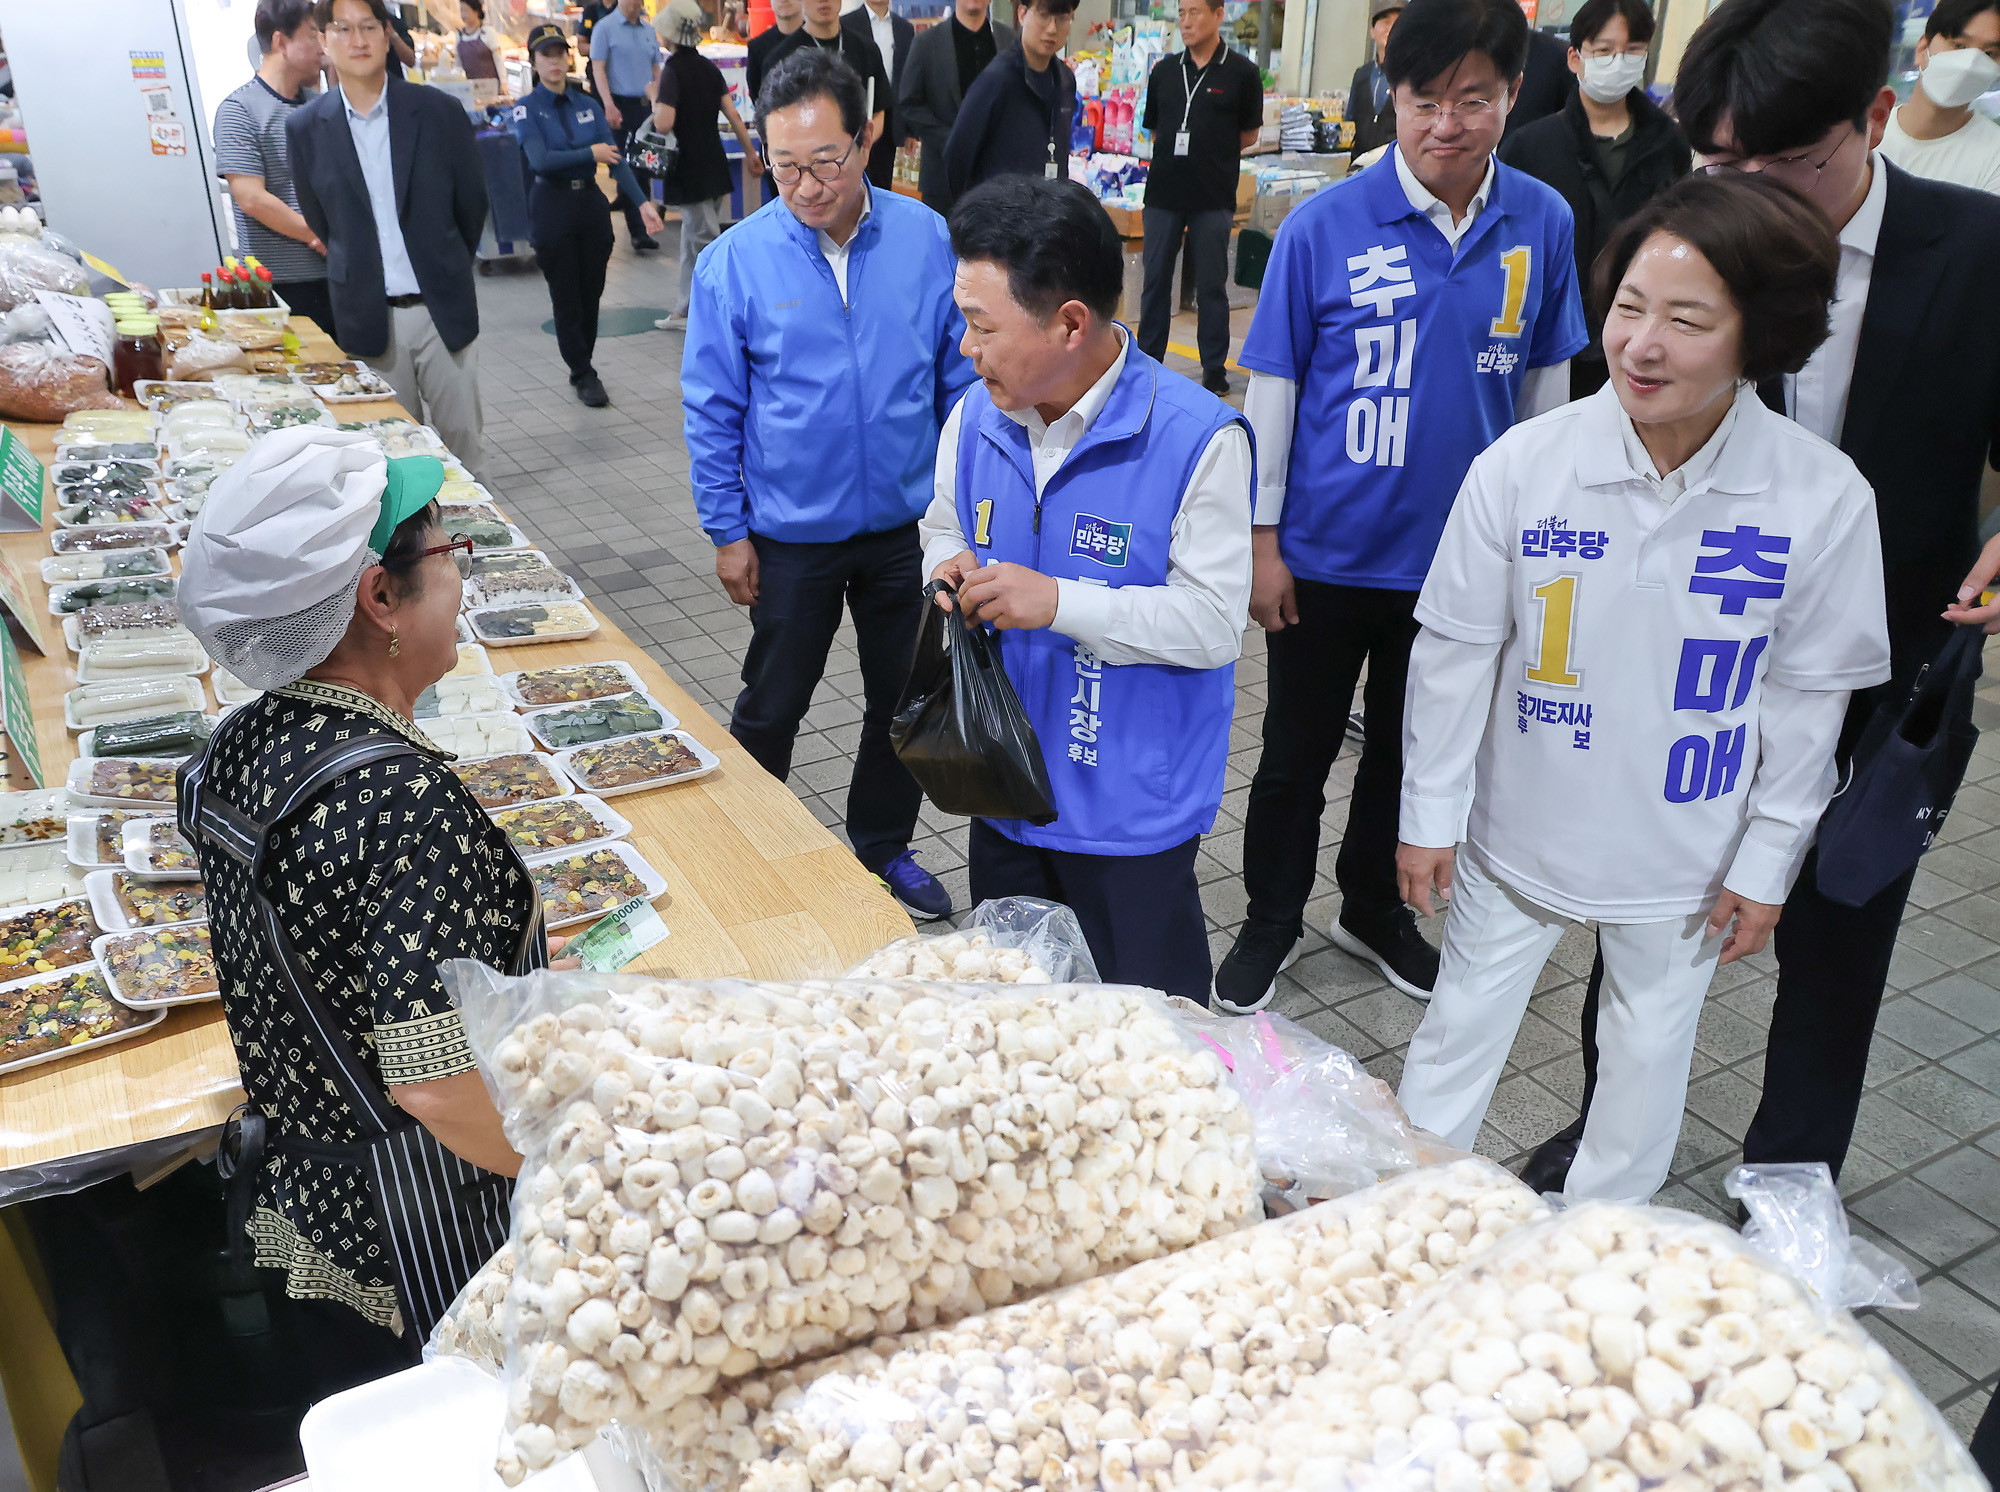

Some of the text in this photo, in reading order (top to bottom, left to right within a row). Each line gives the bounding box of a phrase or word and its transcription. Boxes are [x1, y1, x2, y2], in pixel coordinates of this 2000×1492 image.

[1488, 245, 1532, 338] 1
[1345, 244, 1417, 467] 추미애
[1476, 351, 1519, 375] 민주당
[975, 498, 994, 548] 1
[1536, 515, 1568, 531] 더불어
[1075, 528, 1126, 556] 민주당
[1521, 529, 1610, 560] 민주당
[1523, 571, 1585, 692] 1
[1664, 525, 1792, 804] 추미애
[1517, 690, 1593, 728] 경기도지사
[1067, 742, 1099, 767] 후보
[1915, 806, 1934, 820] MY
[611, 897, 644, 923] 10000
